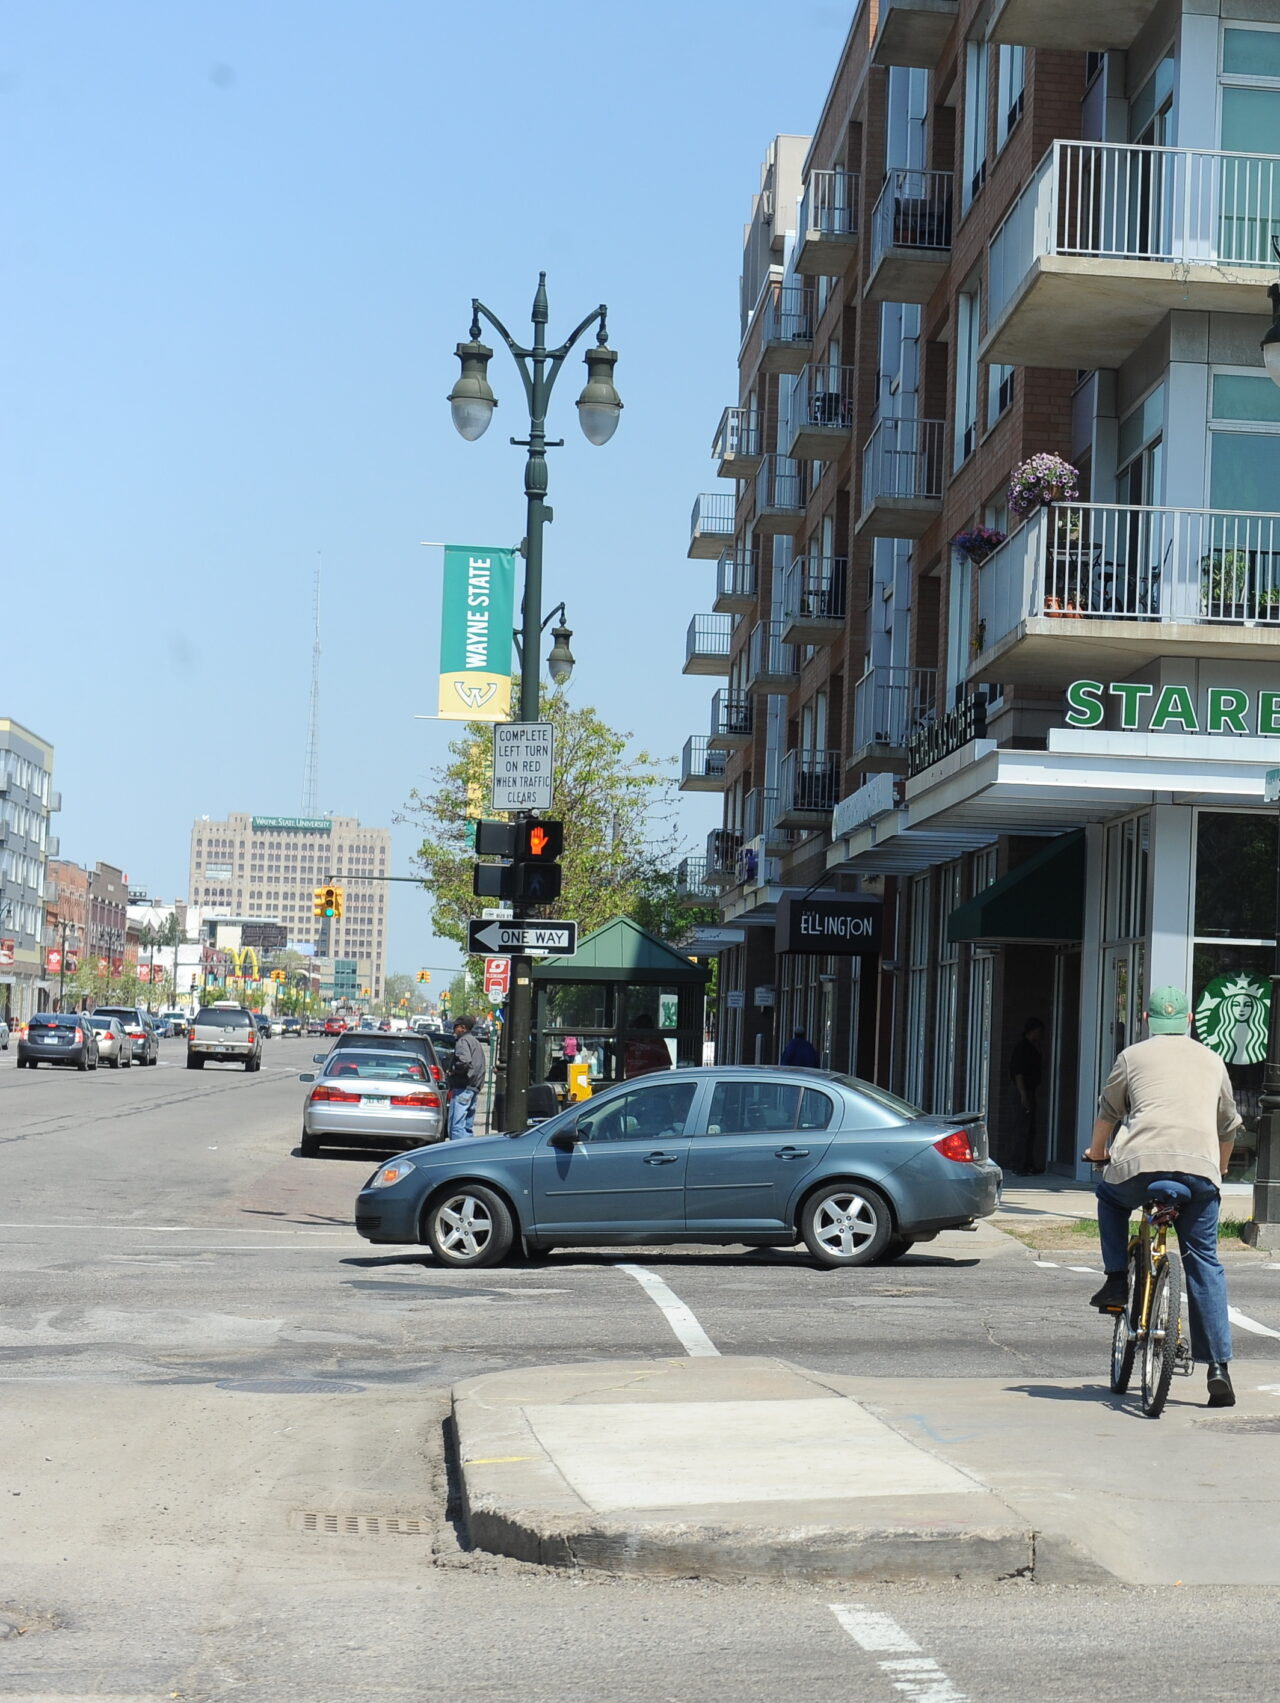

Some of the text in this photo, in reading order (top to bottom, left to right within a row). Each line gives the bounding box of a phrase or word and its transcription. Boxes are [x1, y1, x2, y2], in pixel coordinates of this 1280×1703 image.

[465, 557, 491, 669] WAYNE STATE
[499, 729, 549, 742] COMPLETE
[498, 745, 549, 757] LEFT TURN
[505, 761, 541, 772] ON RED
[496, 776, 550, 788] WHEN TRAFFIC
[507, 792, 537, 803] CLEARS
[800, 913, 873, 940] ELLINGTON
[501, 930, 565, 944] ONE WAY
